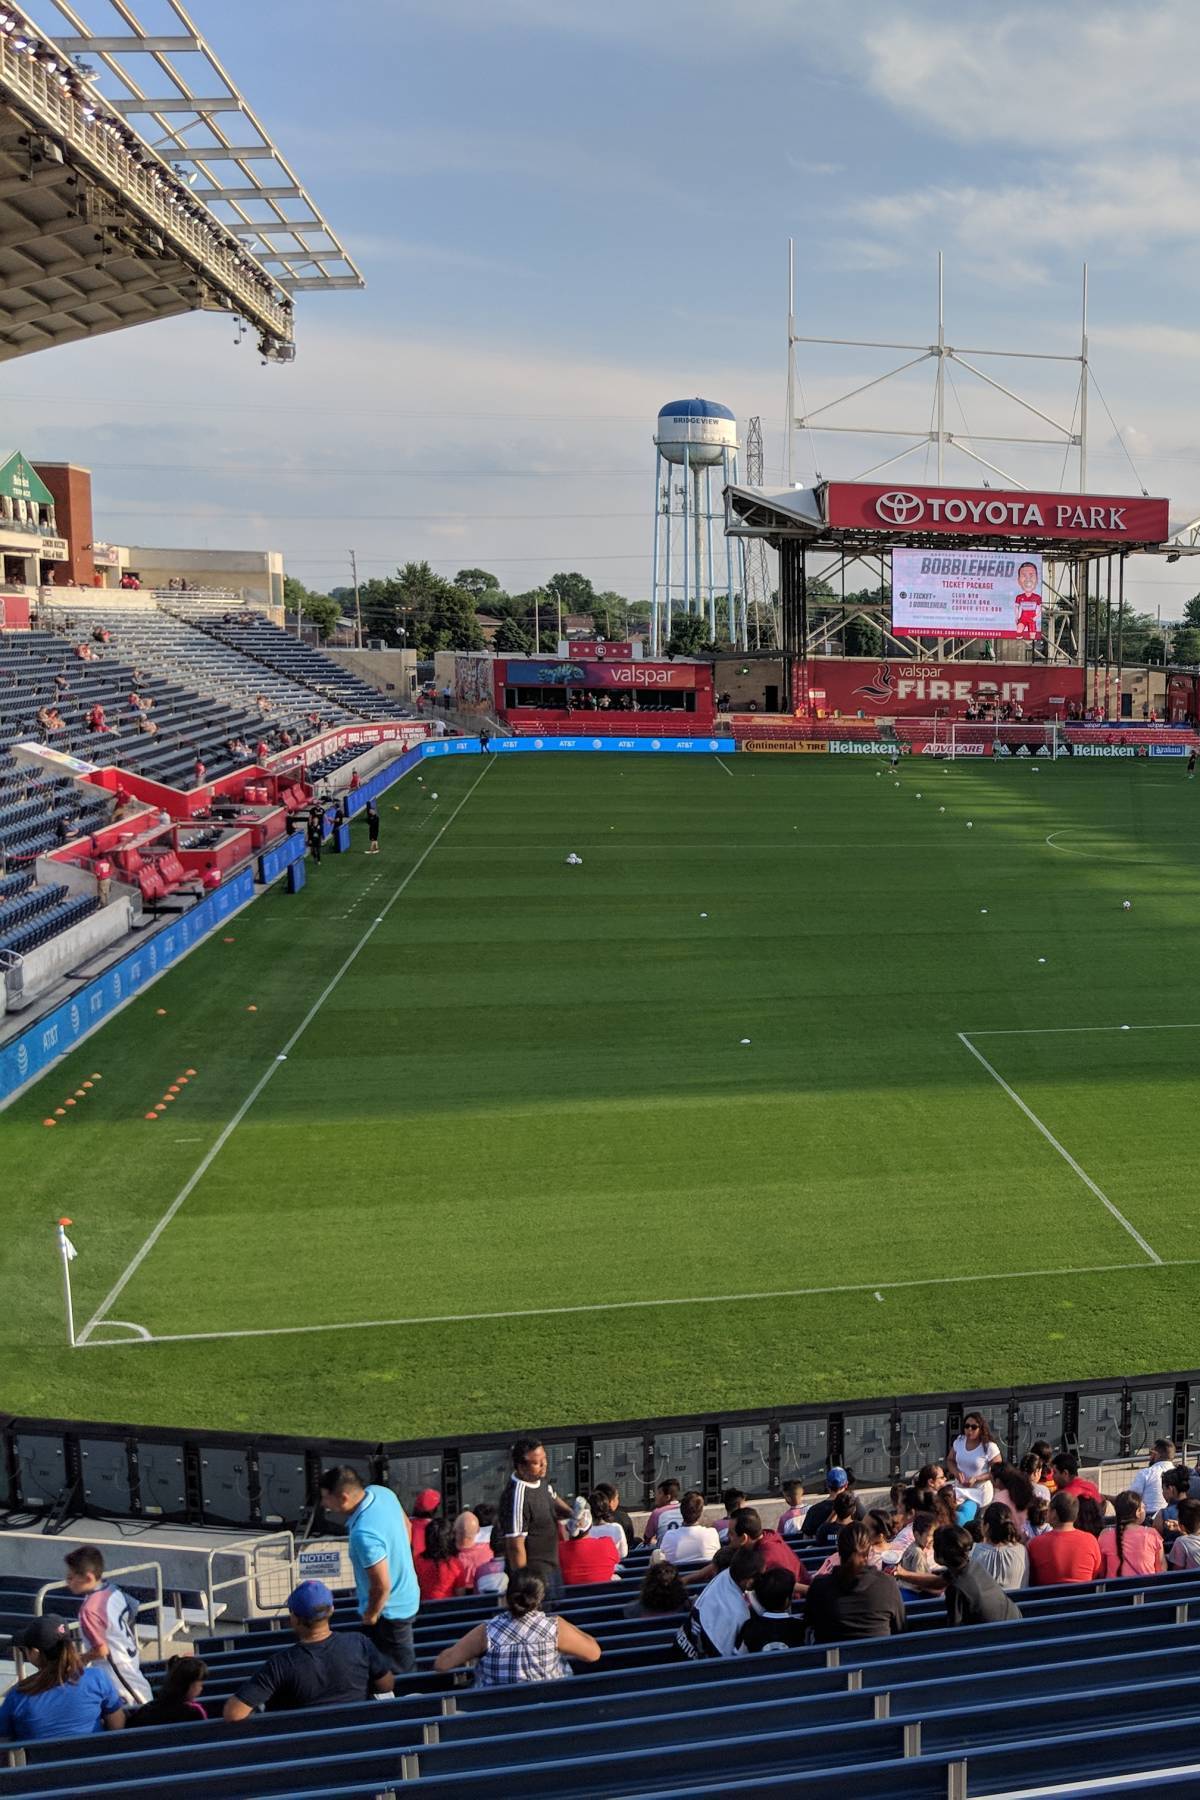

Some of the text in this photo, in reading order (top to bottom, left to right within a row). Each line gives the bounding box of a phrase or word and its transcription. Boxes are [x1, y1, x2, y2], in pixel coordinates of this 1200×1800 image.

[673, 417, 719, 425] BRIDGEVIEW
[926, 498, 1128, 531] TOYOTA PARK
[920, 557, 1015, 578] BOBBLEHEAD
[942, 580, 994, 590] TICKET PACKAGE
[611, 665, 675, 685] valspar
[899, 665, 944, 680] valspar
[745, 740, 797, 750] Continental
[830, 740, 897, 754] Heineken
[1073, 745, 1135, 757] Heineken
[43, 1024, 59, 1051] AT&T
[301, 1553, 338, 1562] NOTICE
